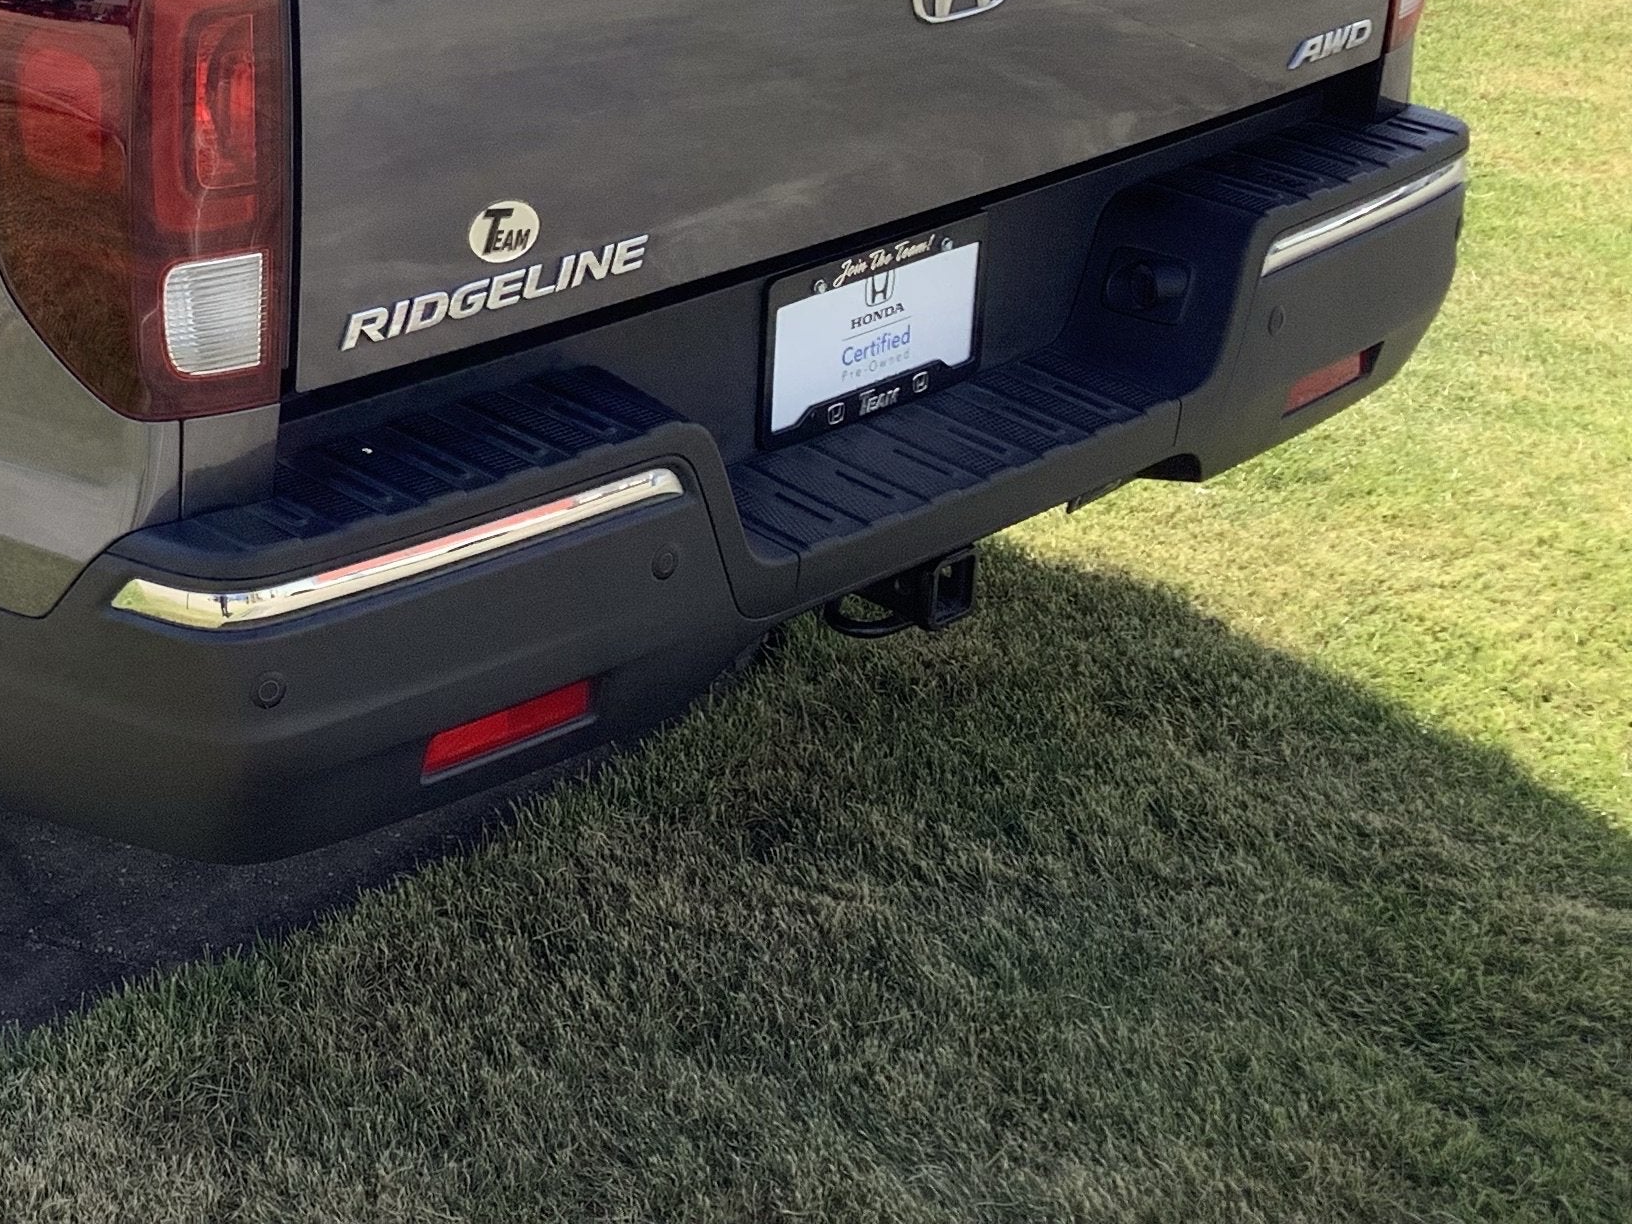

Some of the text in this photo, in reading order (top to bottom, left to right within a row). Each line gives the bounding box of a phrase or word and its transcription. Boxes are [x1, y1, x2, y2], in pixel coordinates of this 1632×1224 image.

[1287, 18, 1373, 71] AWD
[482, 207, 531, 256] TEAM
[833, 234, 935, 288] Join The Team!
[340, 234, 649, 352] RIDGELINE
[850, 302, 905, 330] HONDA
[841, 324, 911, 366] Certified
